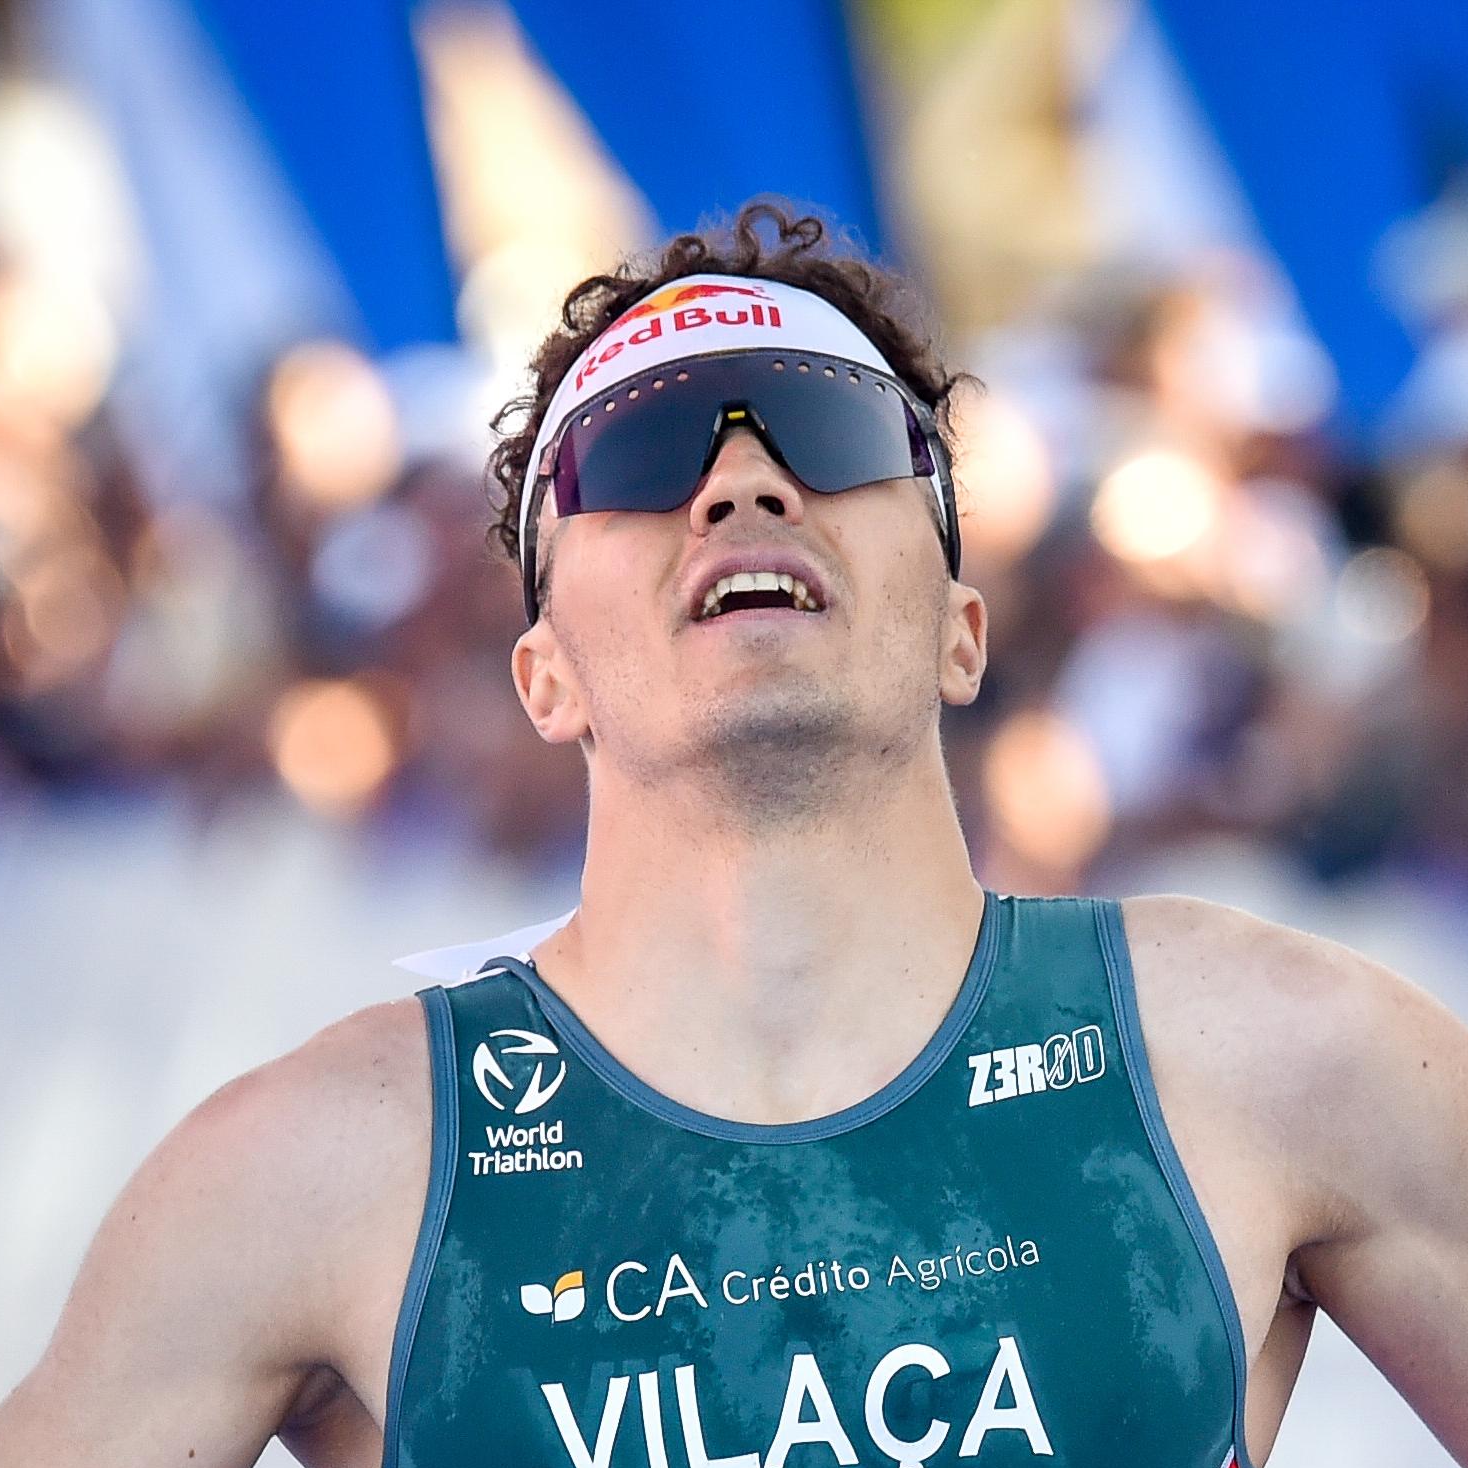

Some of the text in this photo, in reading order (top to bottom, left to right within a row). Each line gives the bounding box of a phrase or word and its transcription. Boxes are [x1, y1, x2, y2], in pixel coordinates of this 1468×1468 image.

[576, 304, 781, 391] Red Bull
[468, 1148, 582, 1175] Triathlon
[486, 1120, 563, 1148] World
[606, 1235, 1040, 1321] CA Crédito Agrícola
